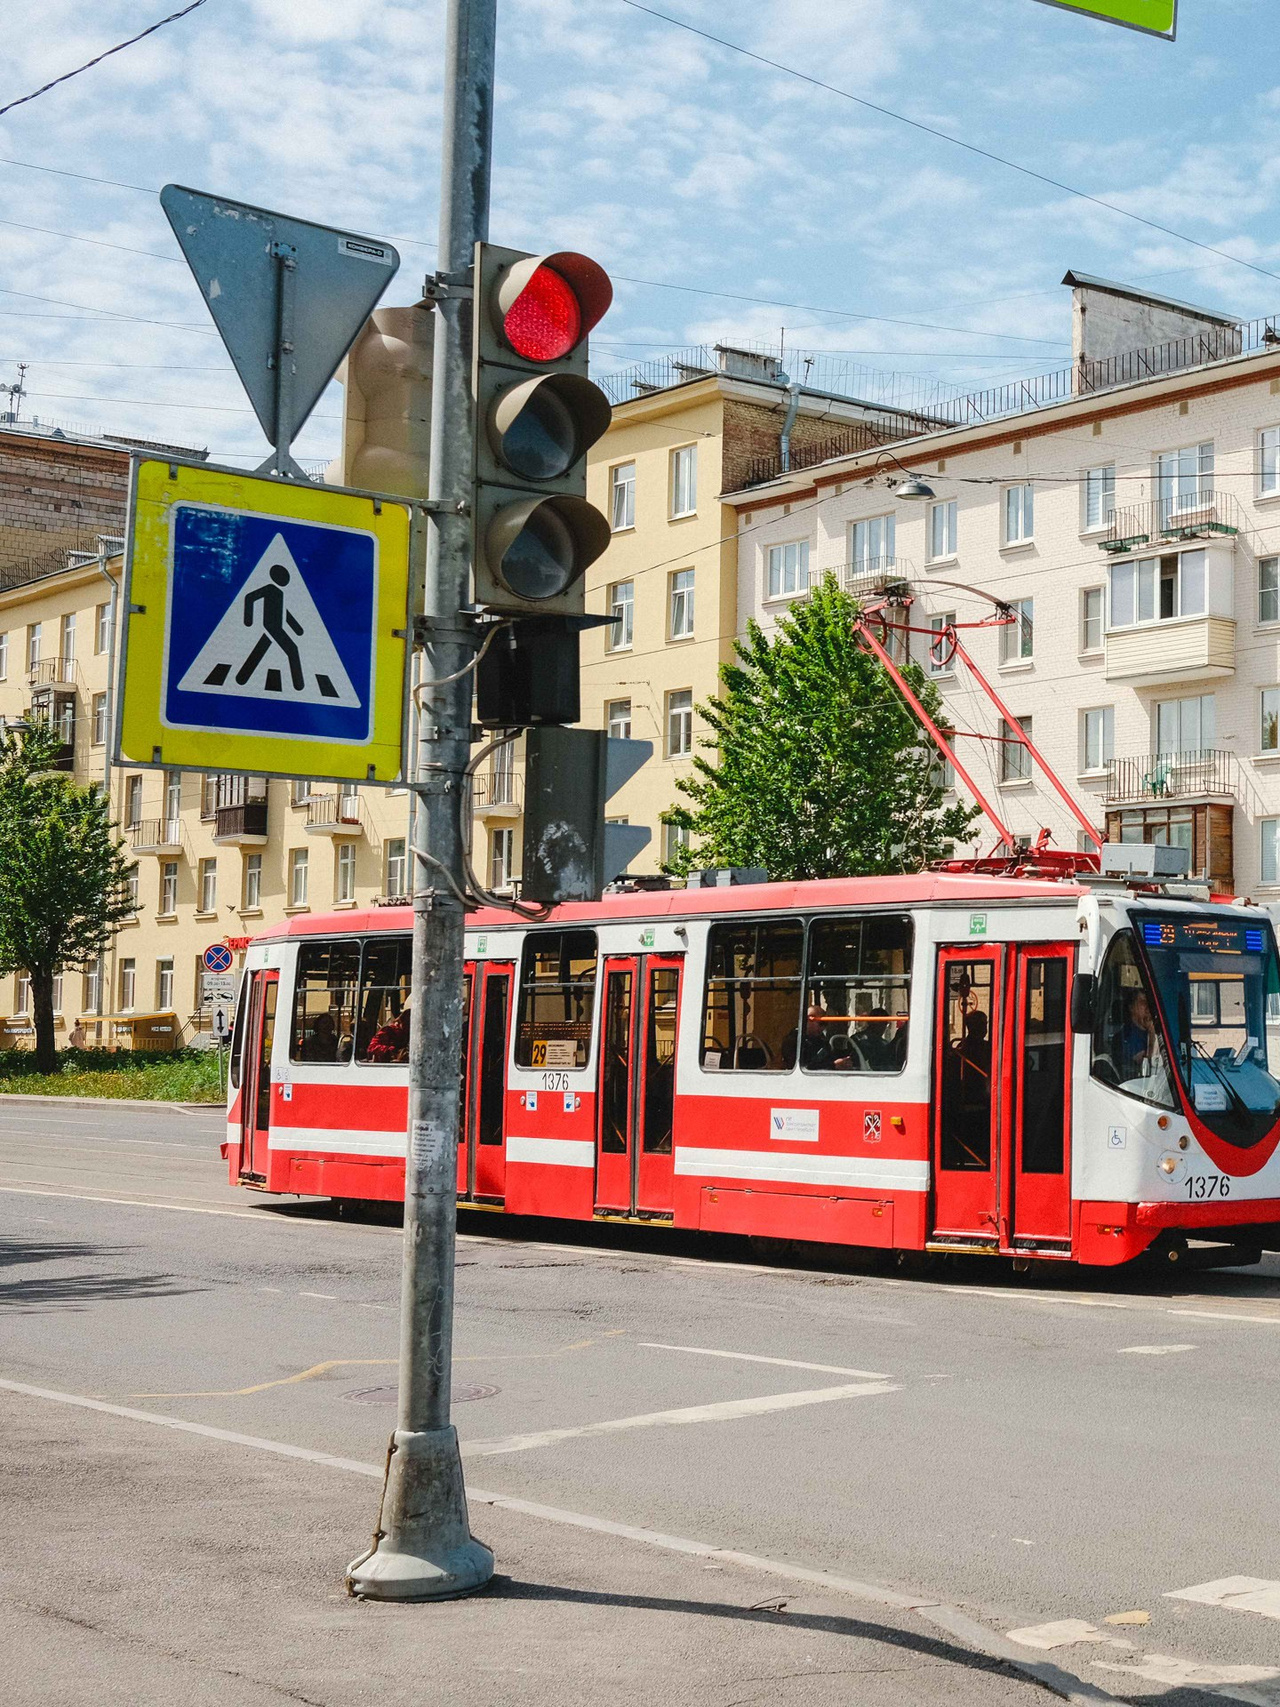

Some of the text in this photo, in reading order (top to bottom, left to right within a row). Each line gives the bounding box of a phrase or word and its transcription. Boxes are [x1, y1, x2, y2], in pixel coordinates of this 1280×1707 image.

[533, 1044, 547, 1064] 29
[542, 1073, 569, 1090] 1376
[1184, 1175, 1231, 1199] 1376
